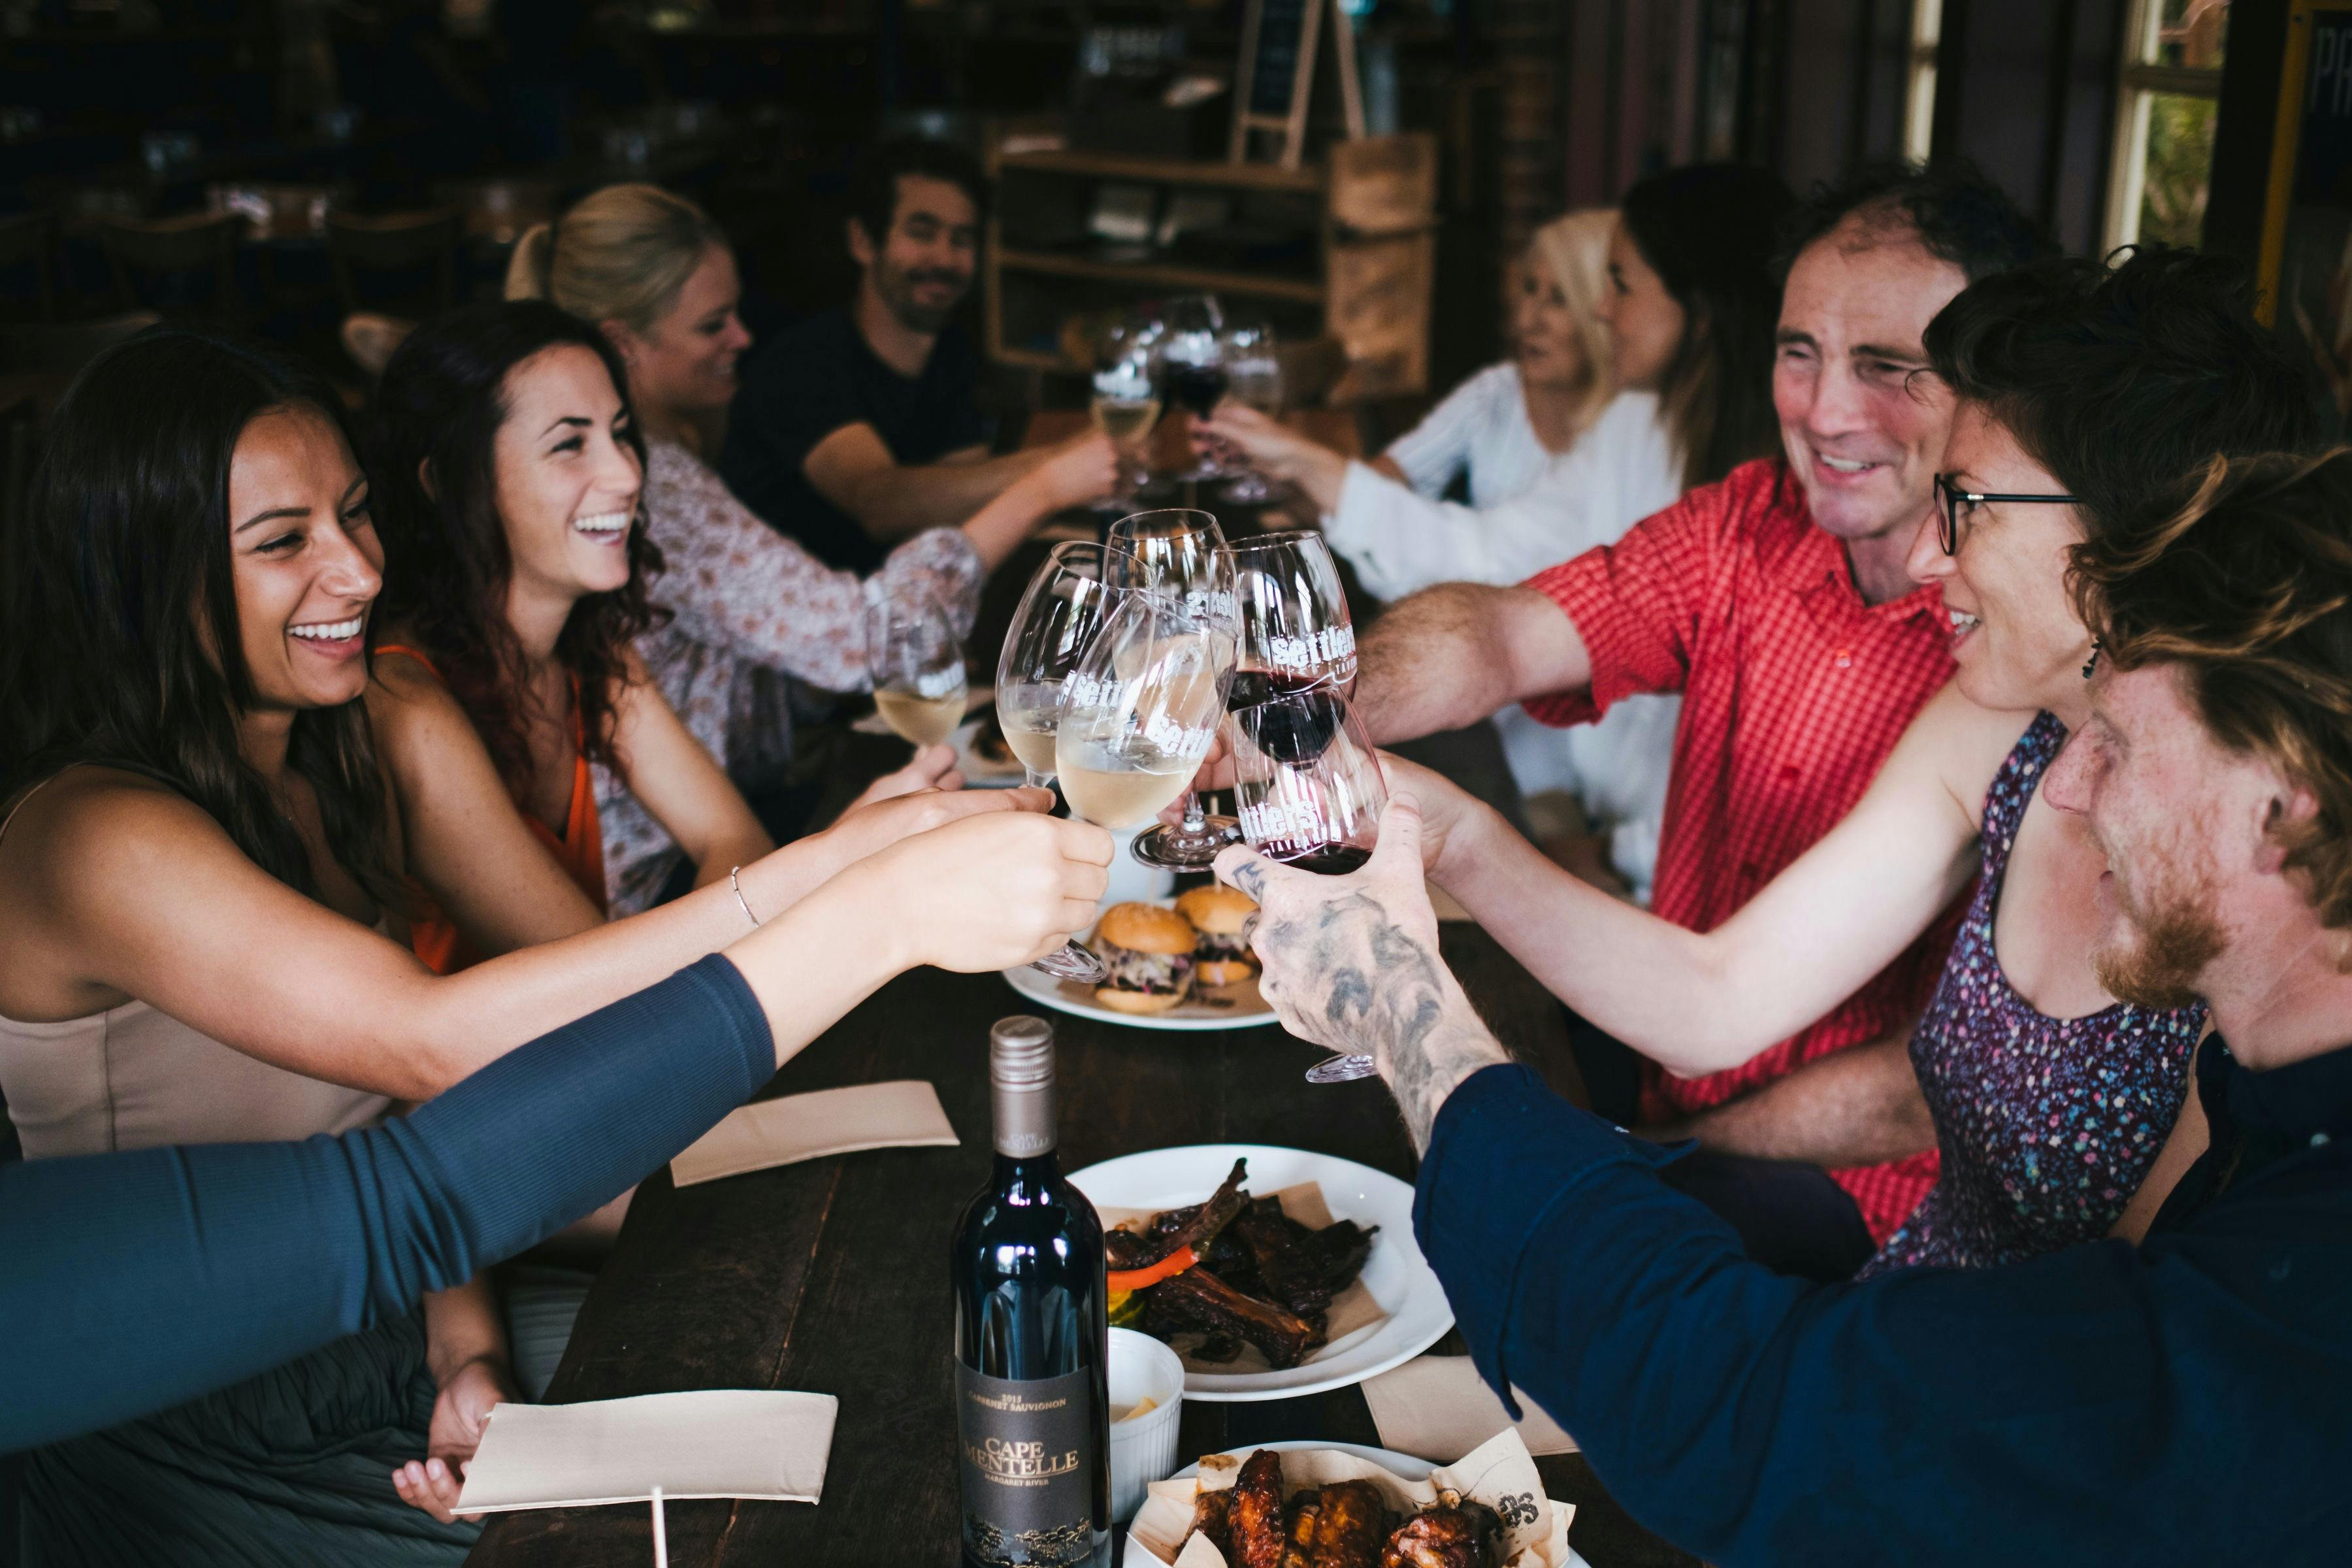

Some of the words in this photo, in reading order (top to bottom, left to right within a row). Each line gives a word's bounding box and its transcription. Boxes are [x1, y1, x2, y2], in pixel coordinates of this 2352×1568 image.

[1011, 1397, 1066, 1412] SAUVIGNON
[964, 1439, 1079, 1475] MENTELLE
[985, 1437, 1045, 1459] CAPE
[985, 1473, 1024, 1487] MARGARET
[1025, 1478, 1049, 1487] RIVER
